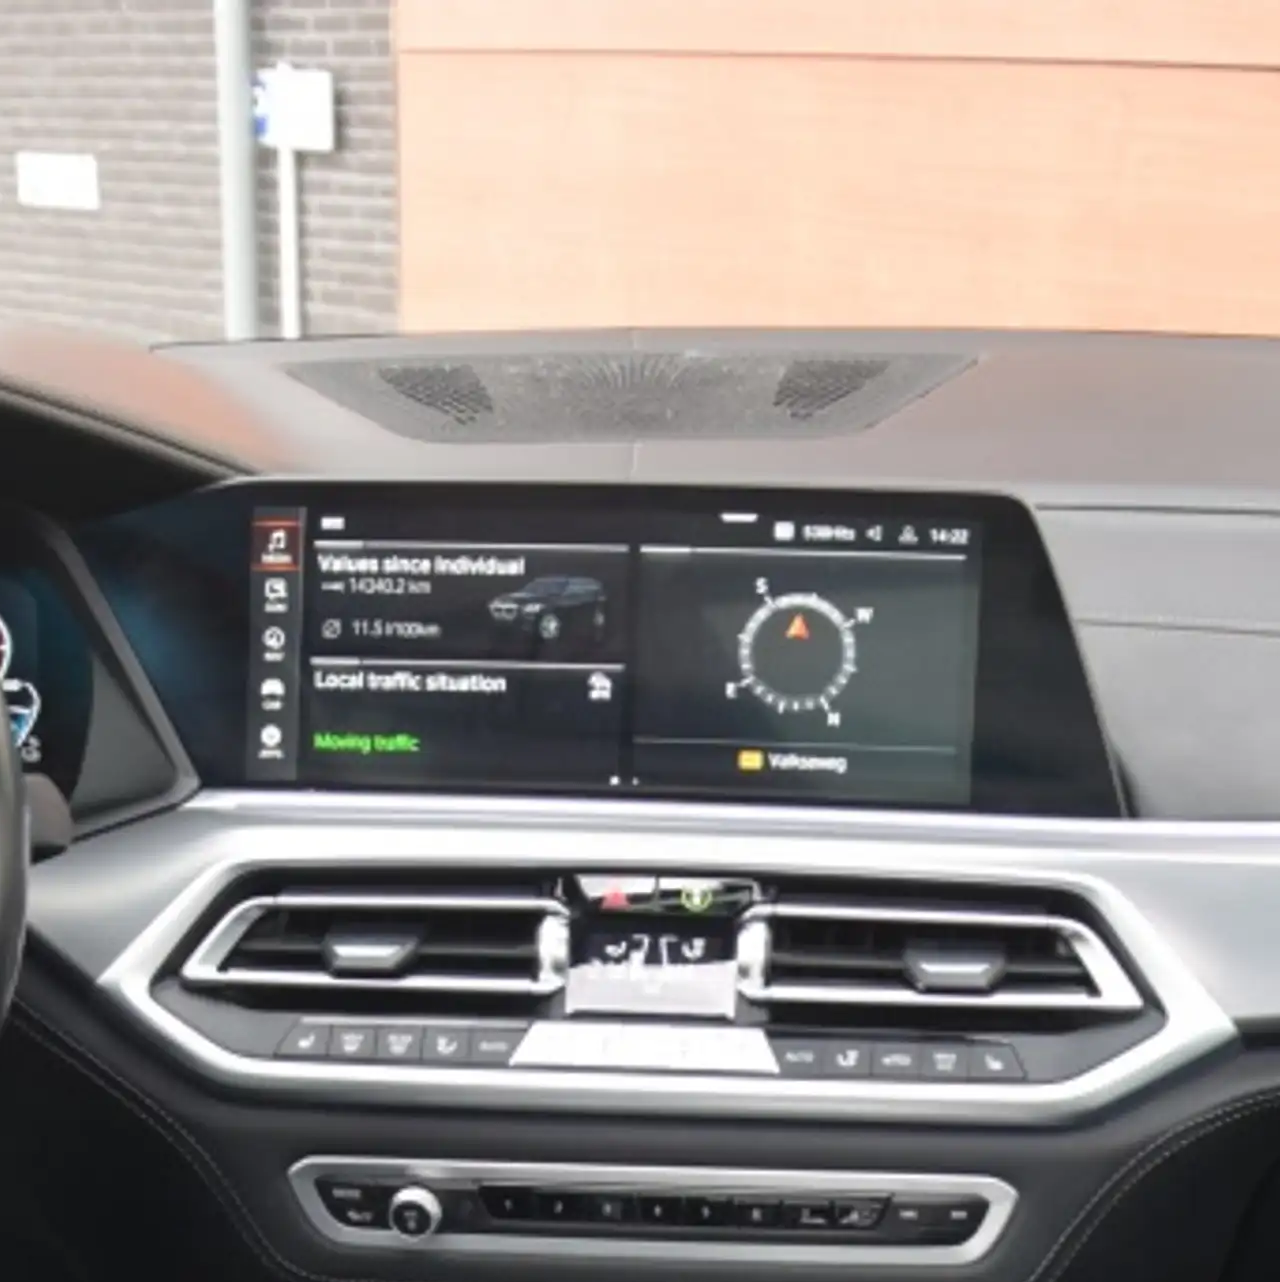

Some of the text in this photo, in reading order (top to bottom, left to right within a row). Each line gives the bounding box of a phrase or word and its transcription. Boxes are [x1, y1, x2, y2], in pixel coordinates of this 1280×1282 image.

[317, 554, 526, 575] Values since Individual
[755, 576, 769, 595] S
[351, 619, 382, 637] 11.5
[314, 671, 508, 693] Local traffic situation
